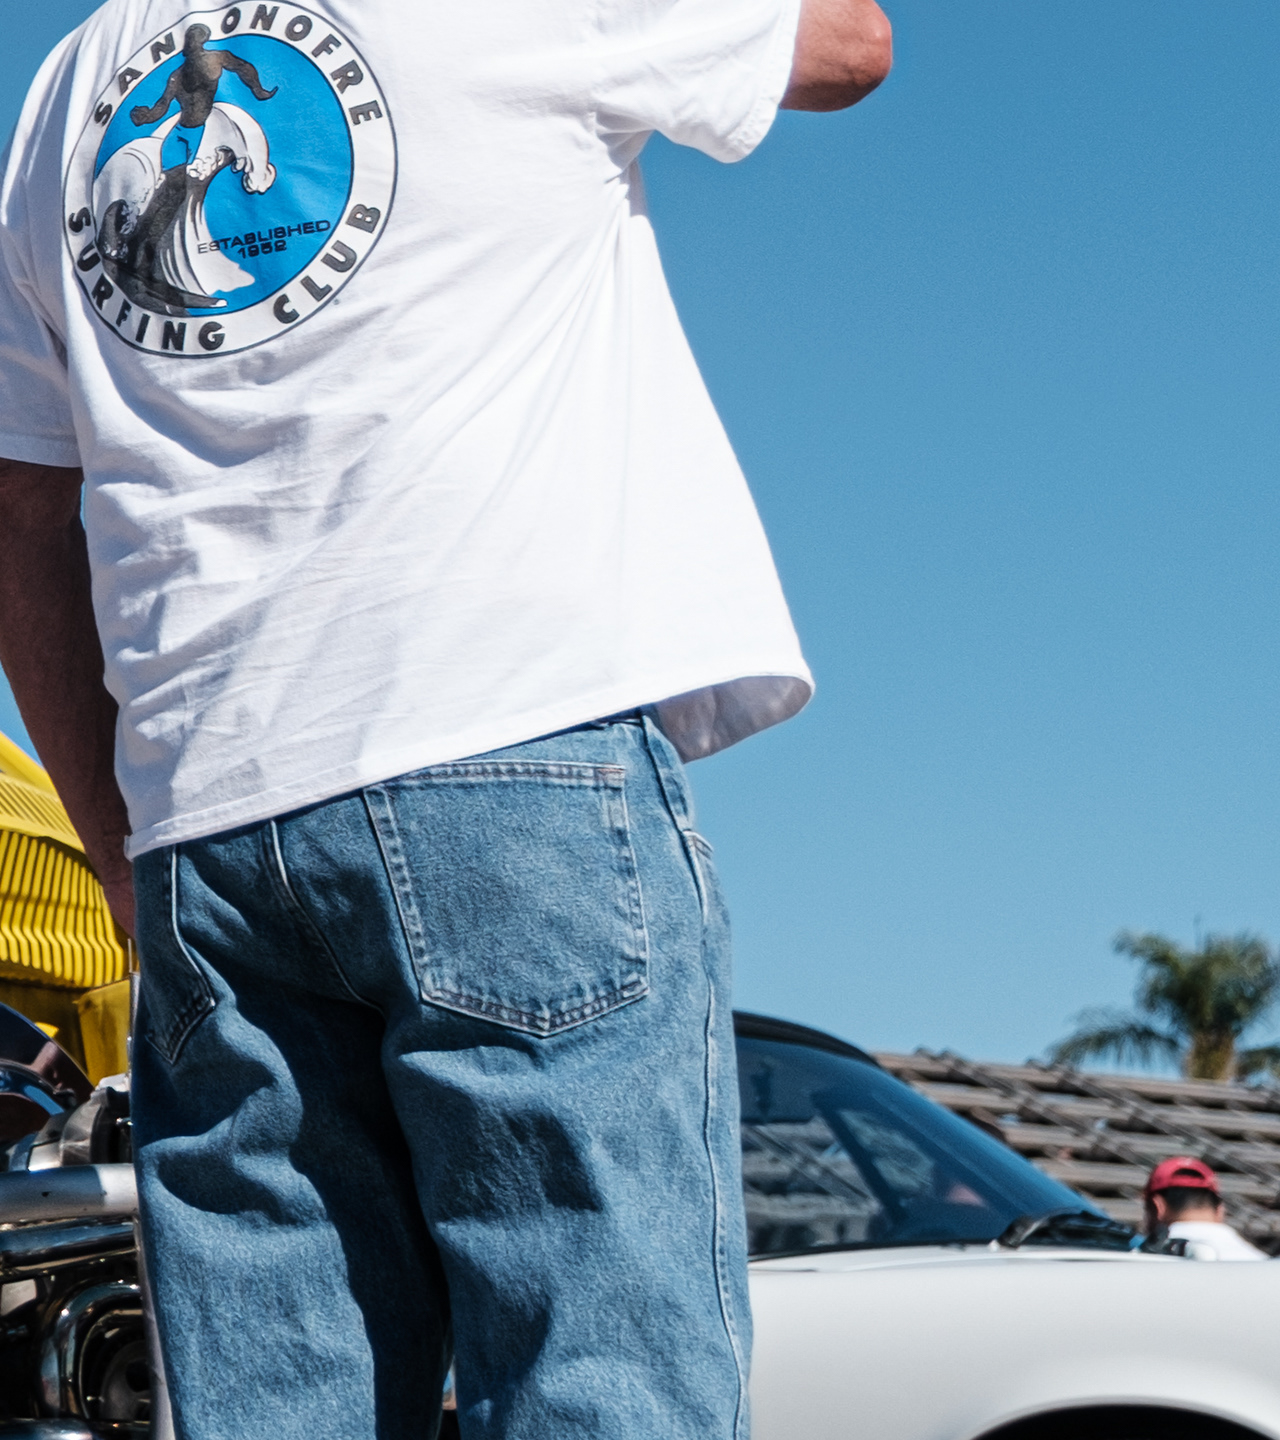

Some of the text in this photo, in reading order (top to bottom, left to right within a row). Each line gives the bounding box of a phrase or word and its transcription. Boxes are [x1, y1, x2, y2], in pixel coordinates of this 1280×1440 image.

[94, 4, 383, 126] SAN ONOFRE
[196, 219, 331, 254] ESTABLISHED
[237, 239, 287, 259] 1952
[68, 204, 382, 352] SURFING CLUB
